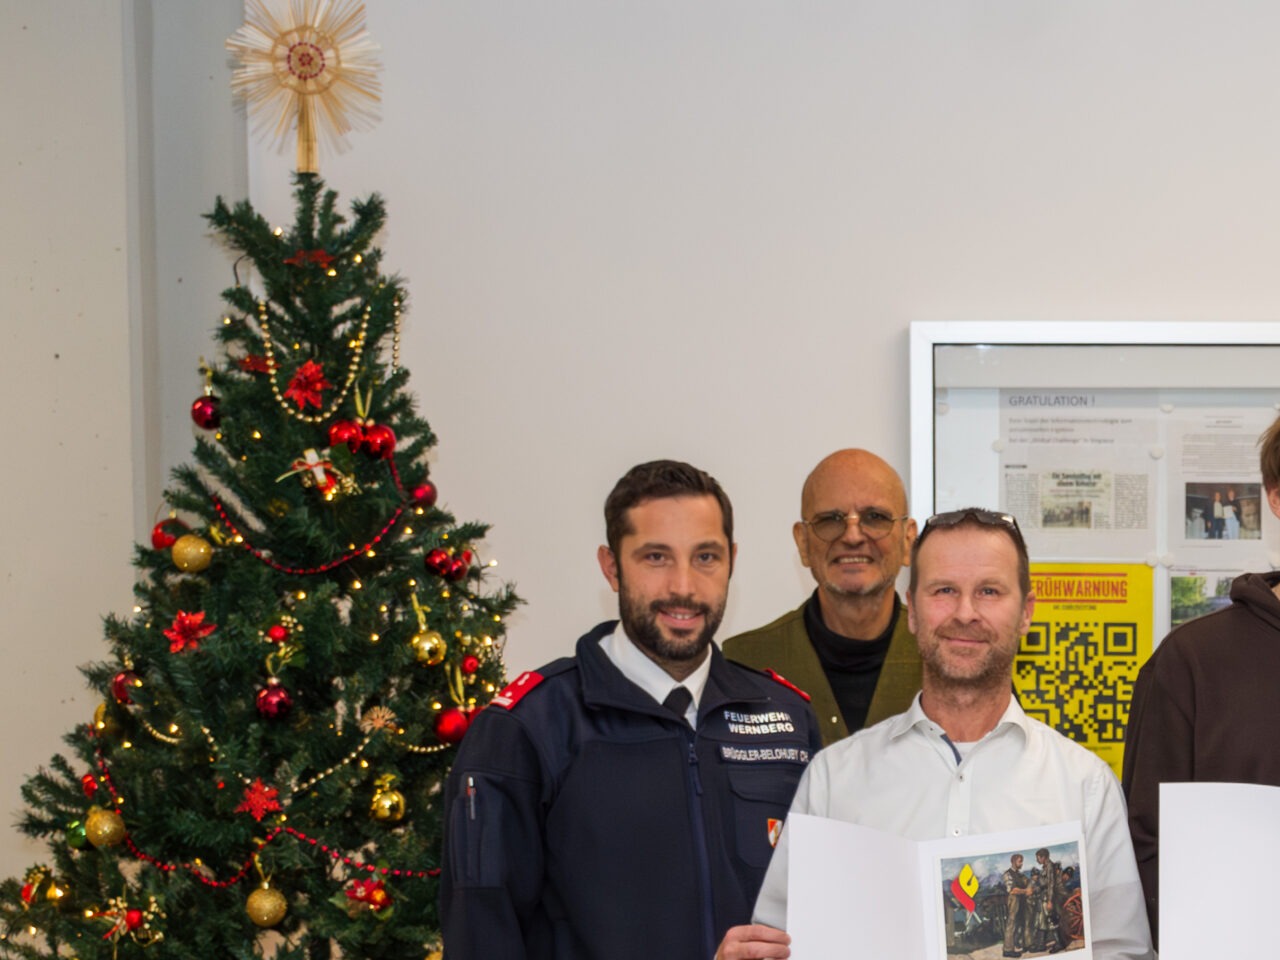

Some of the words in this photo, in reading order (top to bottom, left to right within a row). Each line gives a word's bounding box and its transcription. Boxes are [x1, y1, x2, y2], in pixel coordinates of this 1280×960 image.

[1009, 395, 1088, 406] GRATULATION
[724, 711, 792, 723] FEUERWEHR
[728, 722, 795, 735] WERNBERG
